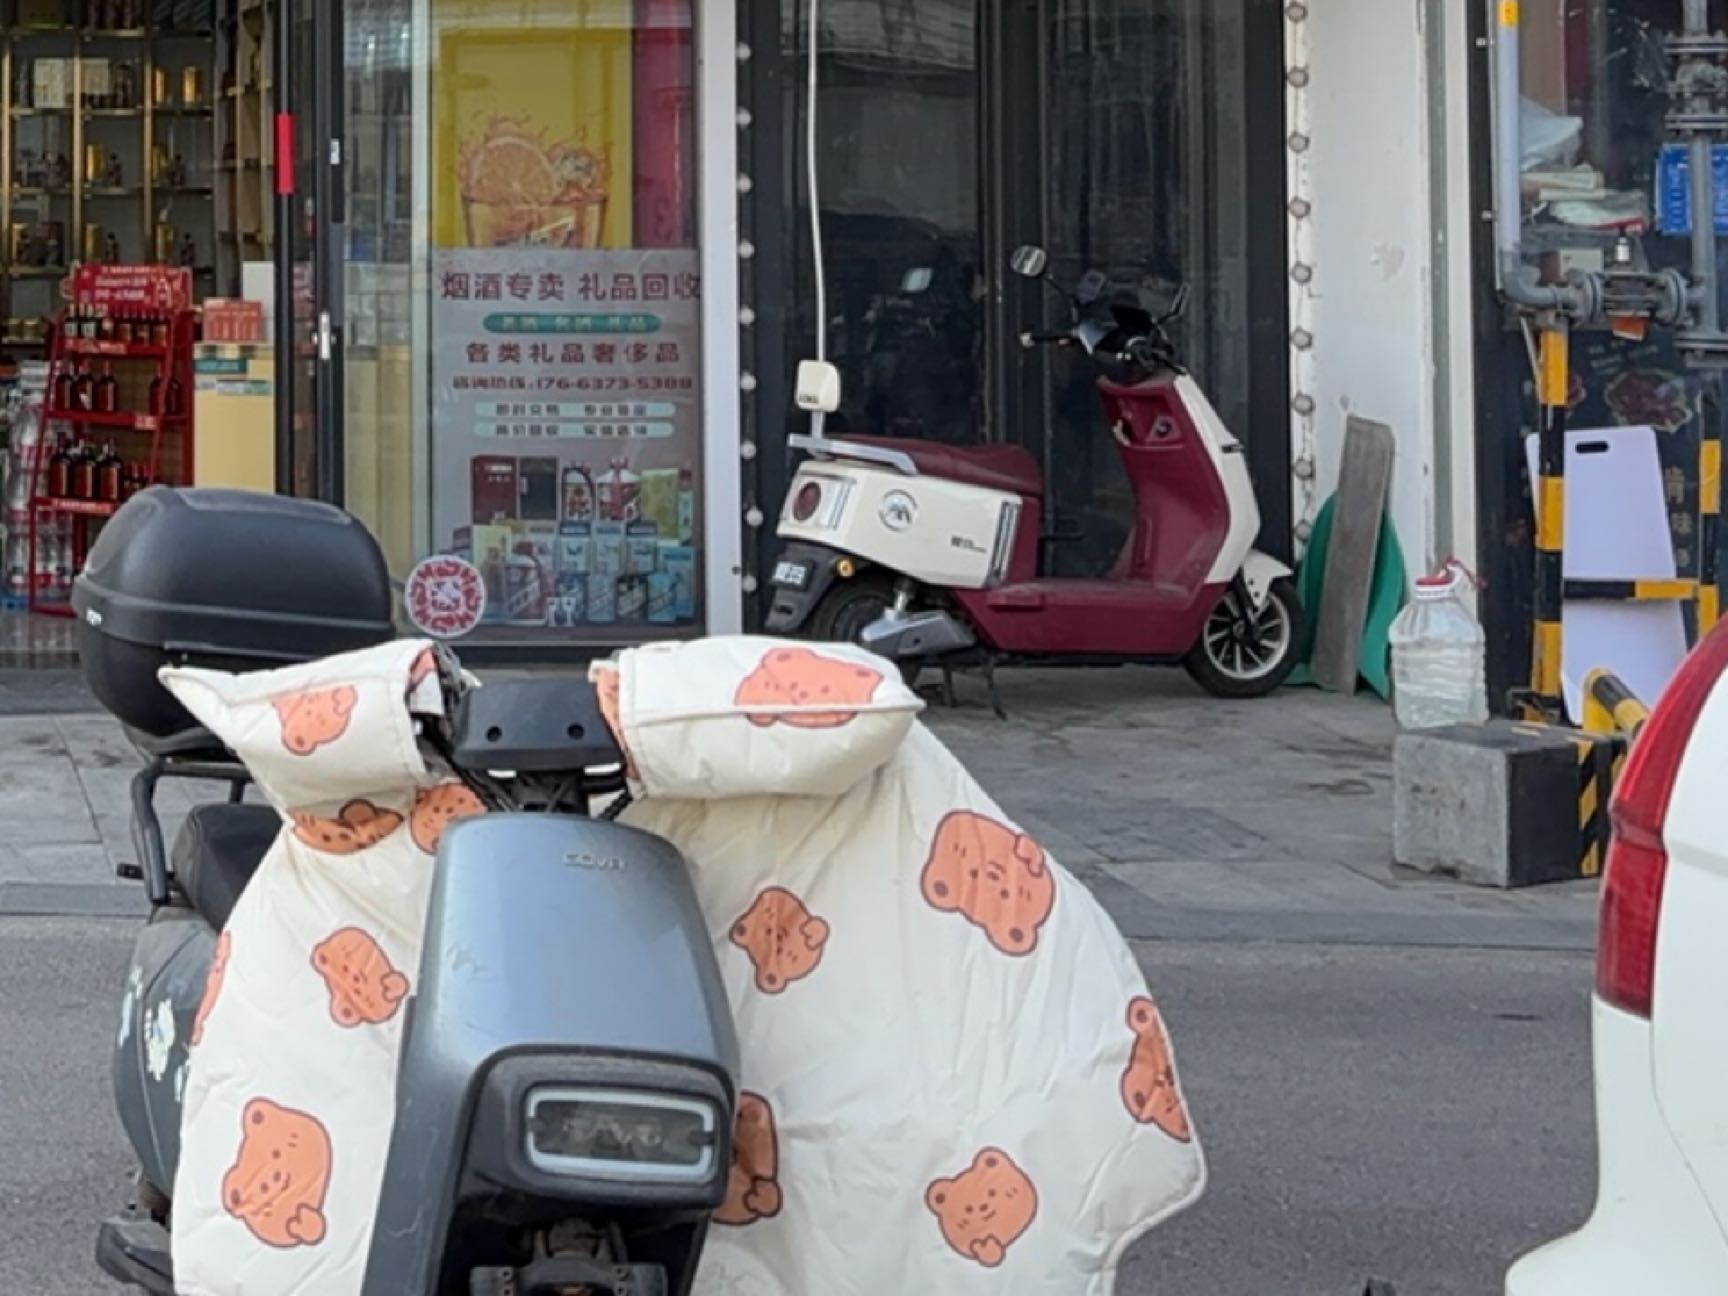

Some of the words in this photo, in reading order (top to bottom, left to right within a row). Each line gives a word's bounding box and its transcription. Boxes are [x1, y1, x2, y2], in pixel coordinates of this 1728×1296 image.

[441, 271, 565, 301] 烟酒专卖
[578, 271, 701, 301] 礼品回收
[466, 342, 679, 364] 各类礼品奢侈品
